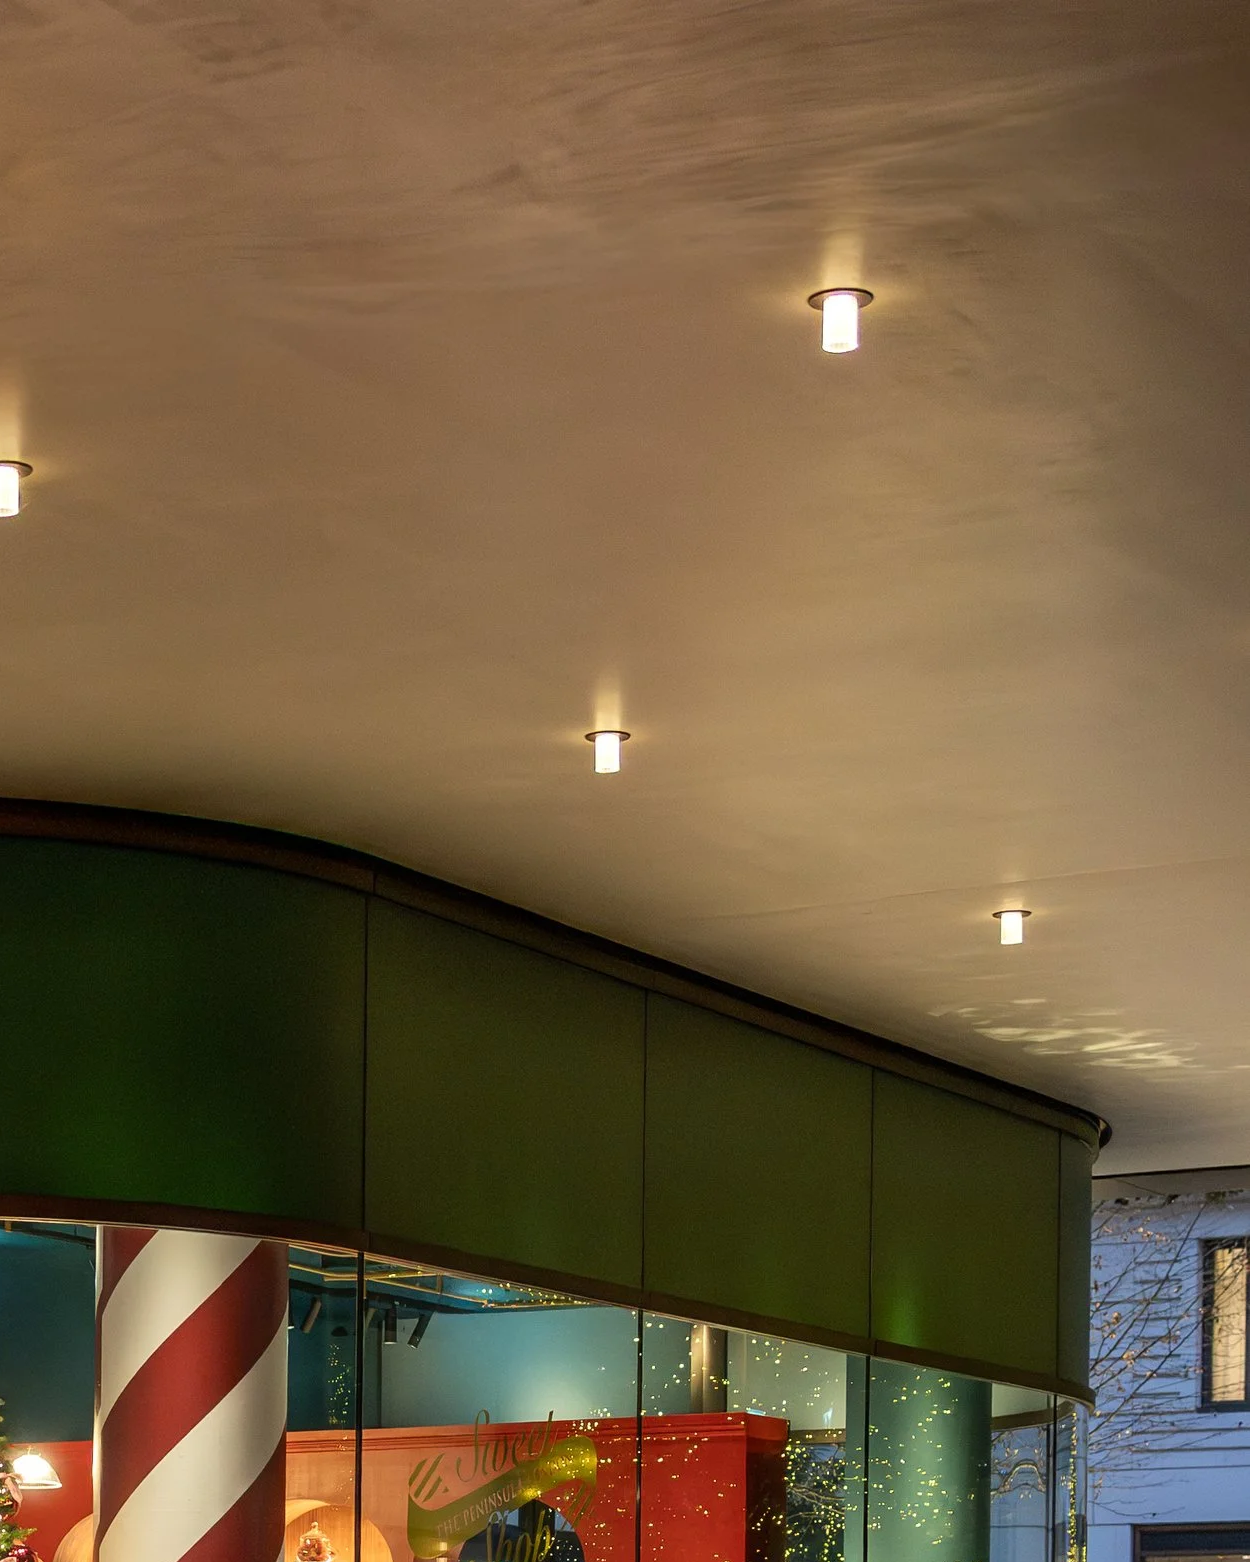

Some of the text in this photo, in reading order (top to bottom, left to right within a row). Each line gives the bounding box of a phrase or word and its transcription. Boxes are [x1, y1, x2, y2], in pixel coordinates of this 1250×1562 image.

[456, 1409, 558, 1482] Sweet
[436, 1515, 461, 1539] THE
[463, 1478, 524, 1527] PENINSULA
